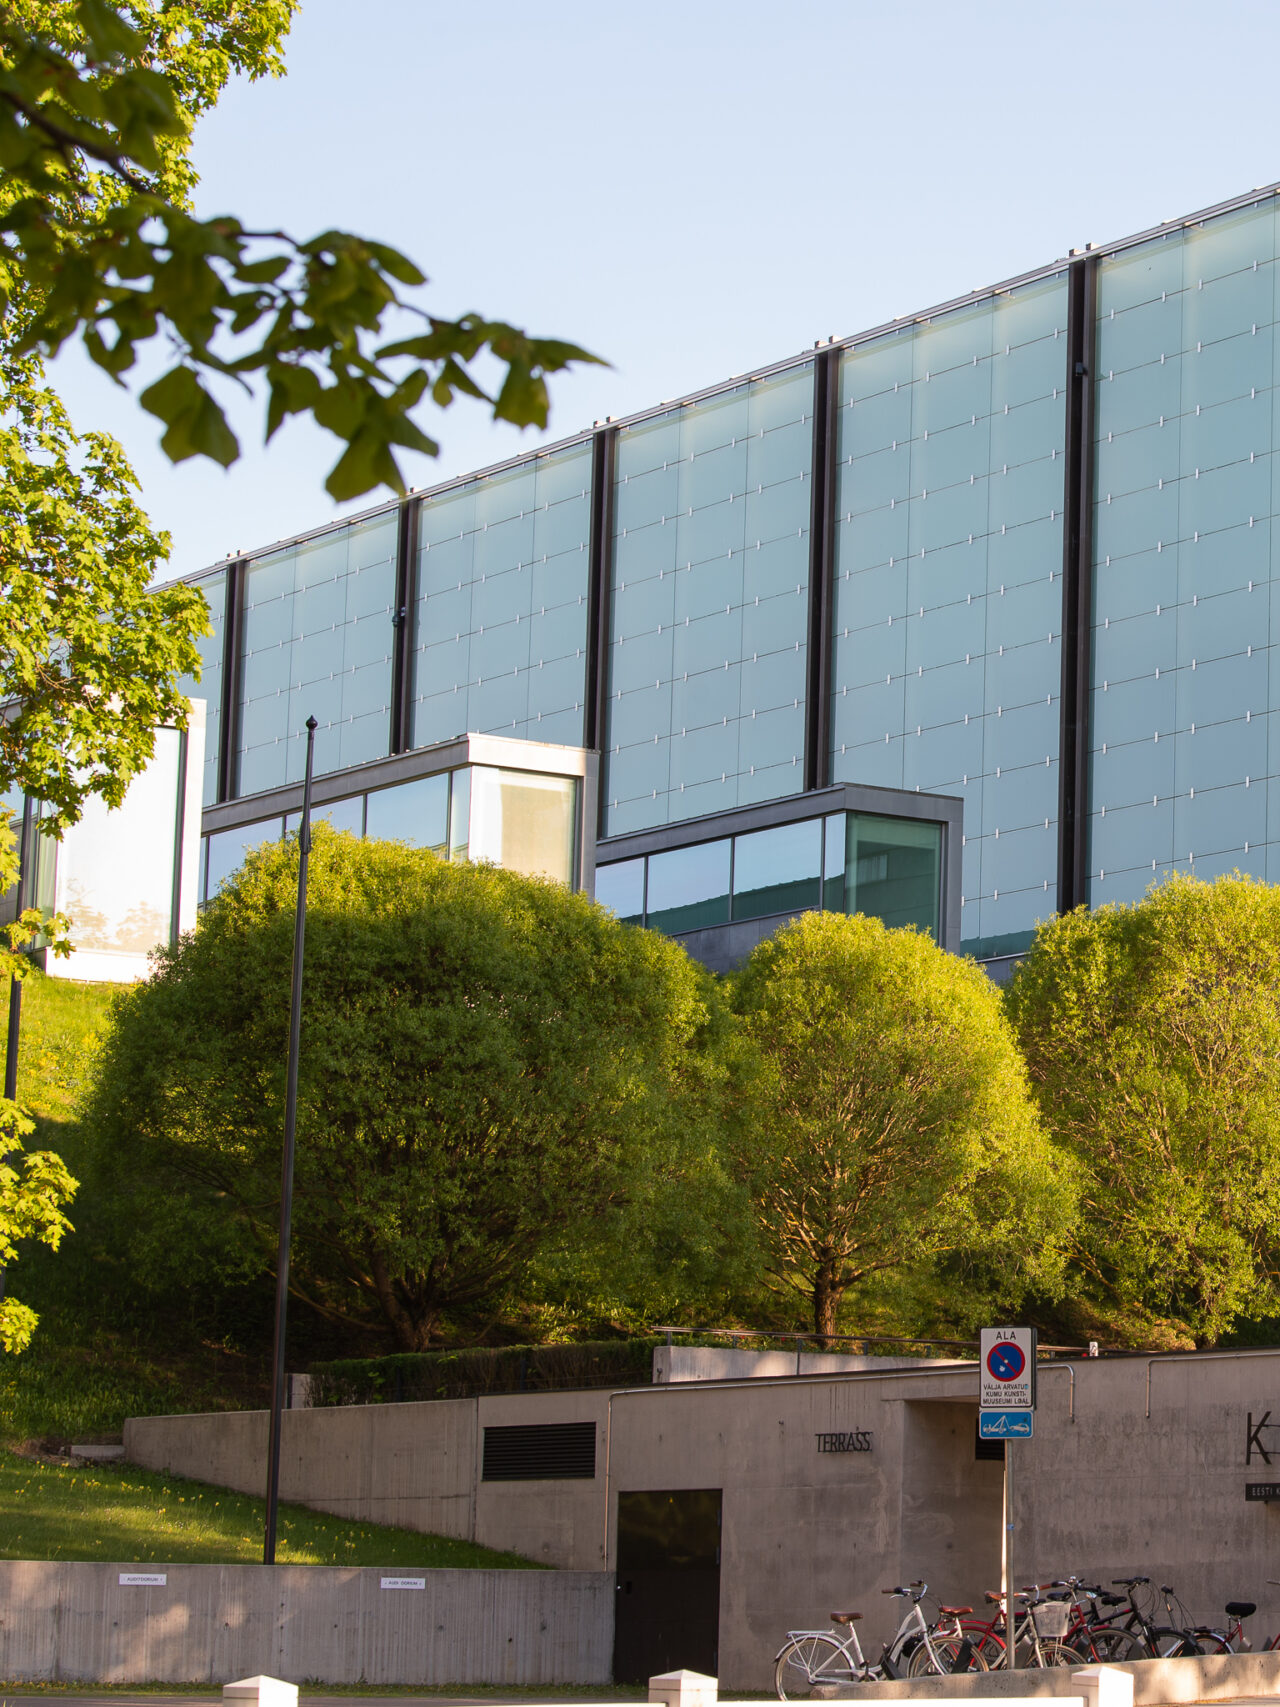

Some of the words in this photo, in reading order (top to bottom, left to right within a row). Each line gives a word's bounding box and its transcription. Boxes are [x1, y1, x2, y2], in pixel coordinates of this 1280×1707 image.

[996, 1331, 1017, 1340] ALA
[815, 1431, 872, 1452] TERRASS
[1252, 1487, 1273, 1496] EESTI
